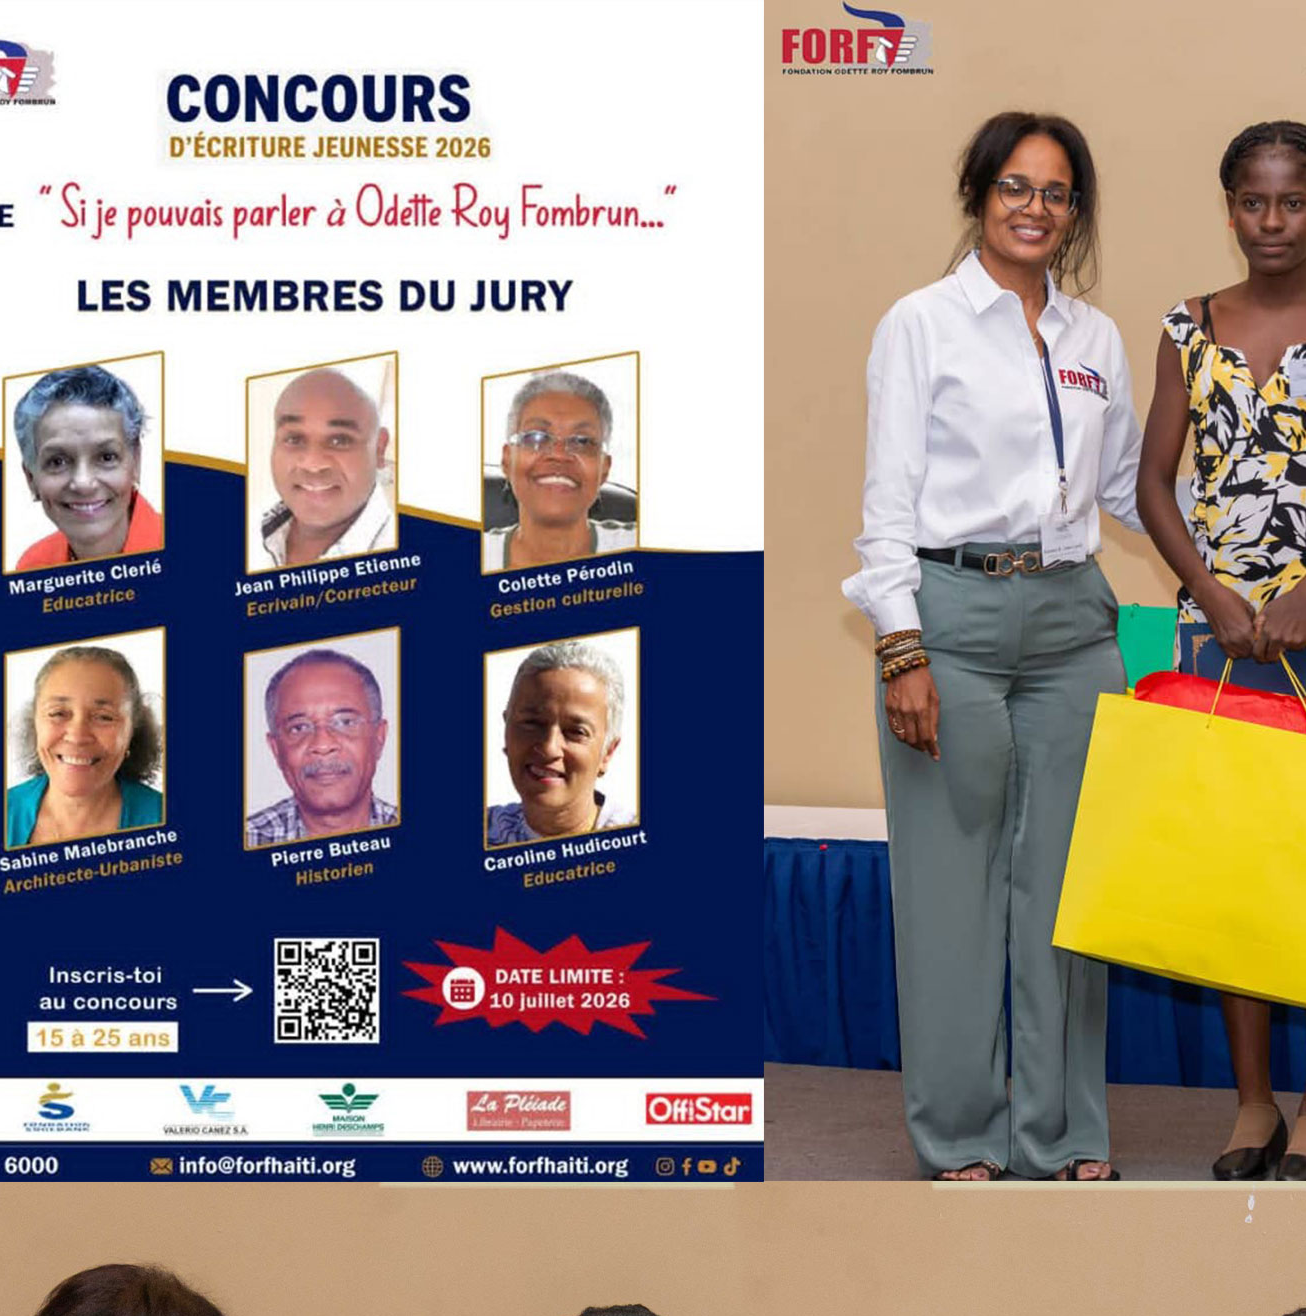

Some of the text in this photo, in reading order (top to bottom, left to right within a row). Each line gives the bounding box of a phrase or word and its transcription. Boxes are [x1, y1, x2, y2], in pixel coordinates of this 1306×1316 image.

[167, 74, 471, 123] CONCOURS
[170, 131, 491, 158] D’ÉCRITURE JEUNESSE 2026
[91, 199, 117, 239] je
[127, 199, 223, 240] pouvais
[233, 193, 316, 239] parler
[327, 199, 347, 227] à
[356, 183, 441, 227] Odette
[451, 182, 509, 239] Roy
[77, 280, 573, 312] LES MEMBRES DU JURY
[8, 558, 162, 595] Marguerite Clerié
[234, 554, 422, 597] Jean Philippe Etienne
[498, 560, 634, 594] Colette Pérodin
[43, 588, 135, 613] Educatrice
[246, 577, 418, 617] Ecrivain/Correcteur
[489, 582, 644, 618] Gestion culturelle
[0, 829, 178, 872] Sabine Malebranche
[271, 837, 391, 867] Pierre Buteau
[484, 830, 648, 871] Caroline Hudicourt
[3, 852, 183, 894] Architecte-Urbaniste
[295, 862, 374, 886] Historien
[523, 860, 616, 888] Educatrice
[49, 966, 162, 984] Inscris-toi
[495, 969, 543, 984] DATE
[549, 969, 614, 984] LIMITE
[39, 995, 178, 1010] au concours
[490, 993, 630, 1012] 10 juillet 2026
[36, 1028, 171, 1047] 15 à 25 ans
[470, 1094, 567, 1113] La Pléiade
[648, 1096, 751, 1123] OffiStar
[163, 1126, 200, 1135] VALERIO
[4, 1156, 59, 1174] 6000
[179, 1156, 356, 1178] info@forfhaiti.org
[453, 1156, 629, 1177] www.forfhaiti.org
